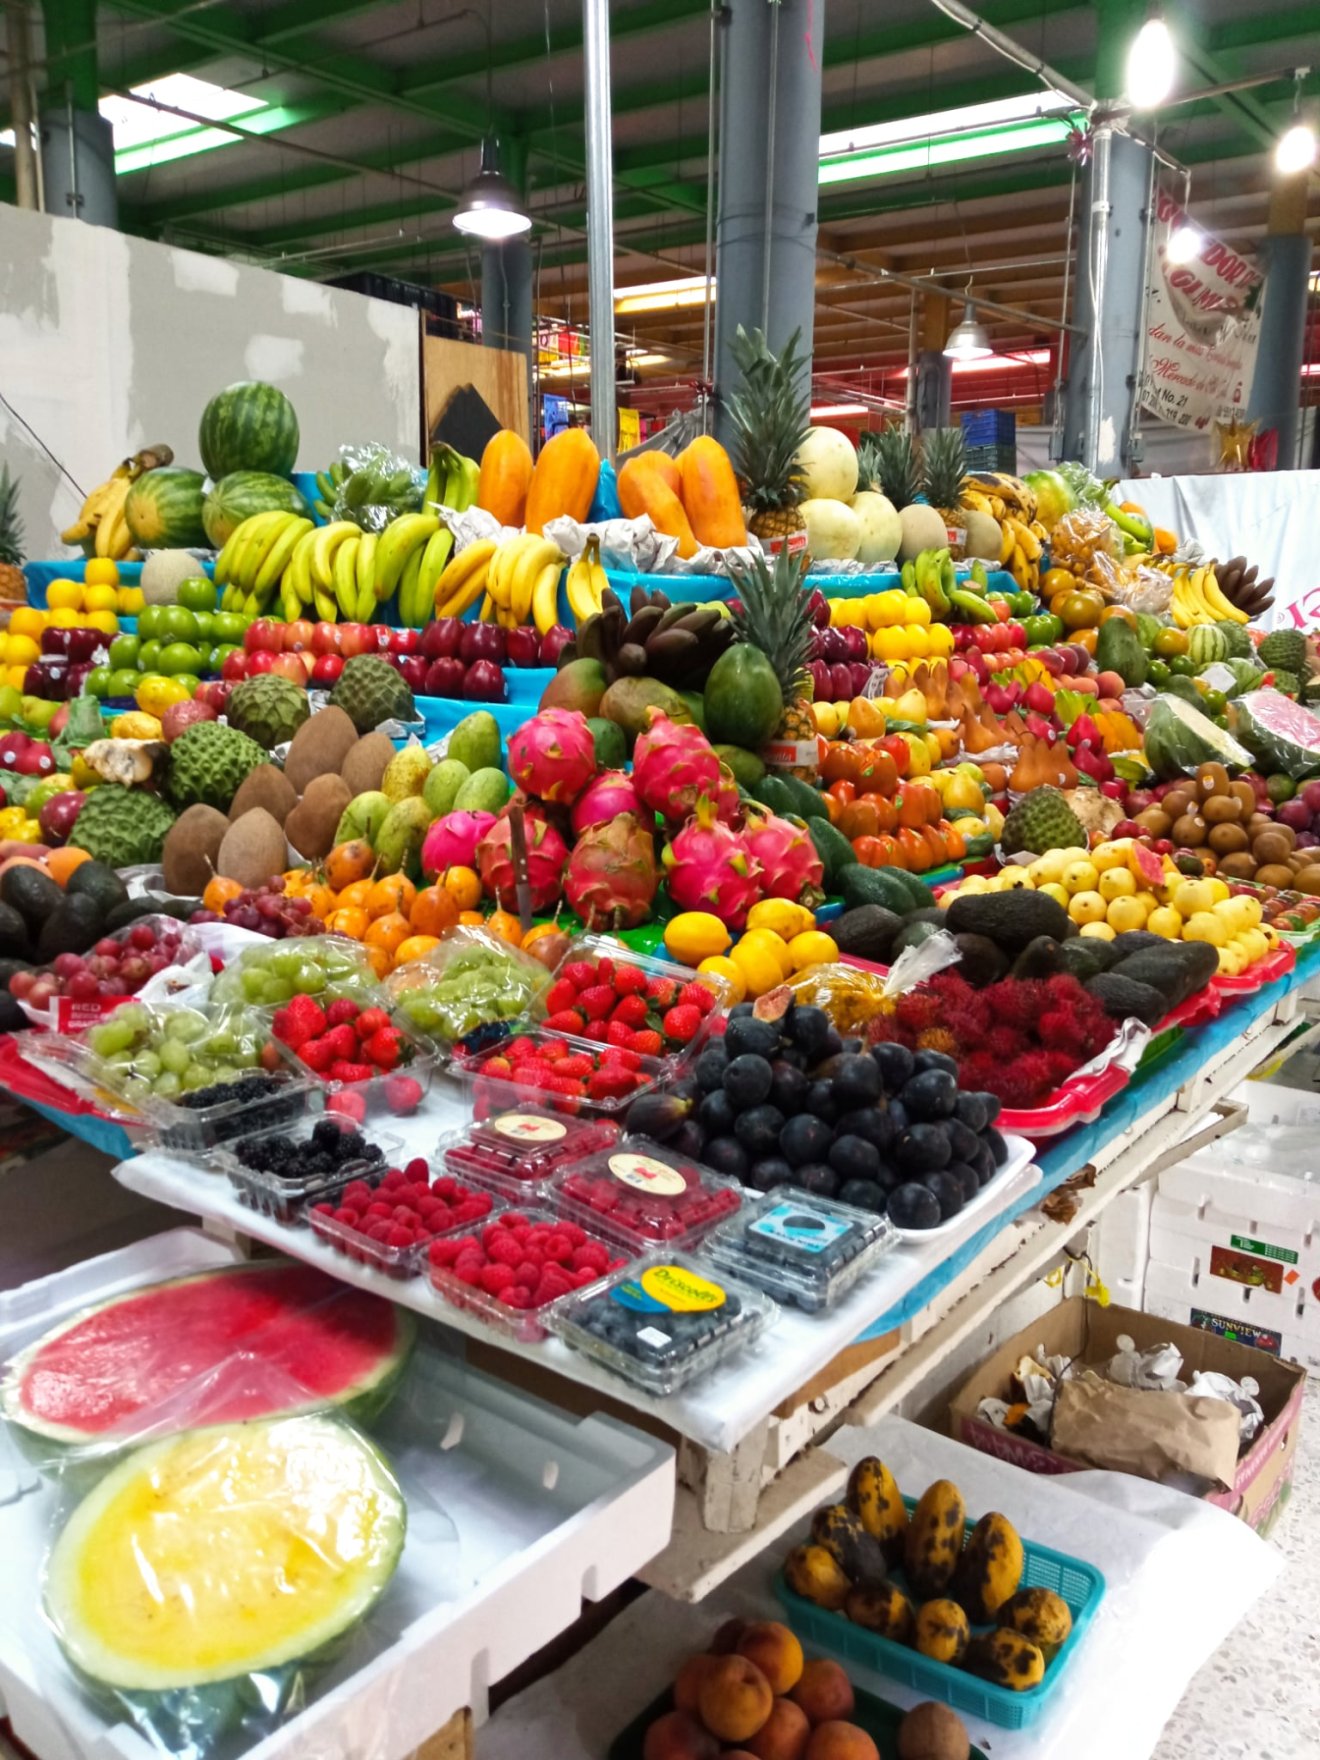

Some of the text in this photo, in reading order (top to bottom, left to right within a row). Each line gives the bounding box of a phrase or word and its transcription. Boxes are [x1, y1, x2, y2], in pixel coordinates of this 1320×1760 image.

[1161, 388, 1176, 404] No.
[1176, 394, 1189, 408] 21
[1211, 1317, 1262, 1338] SUNVIEW
